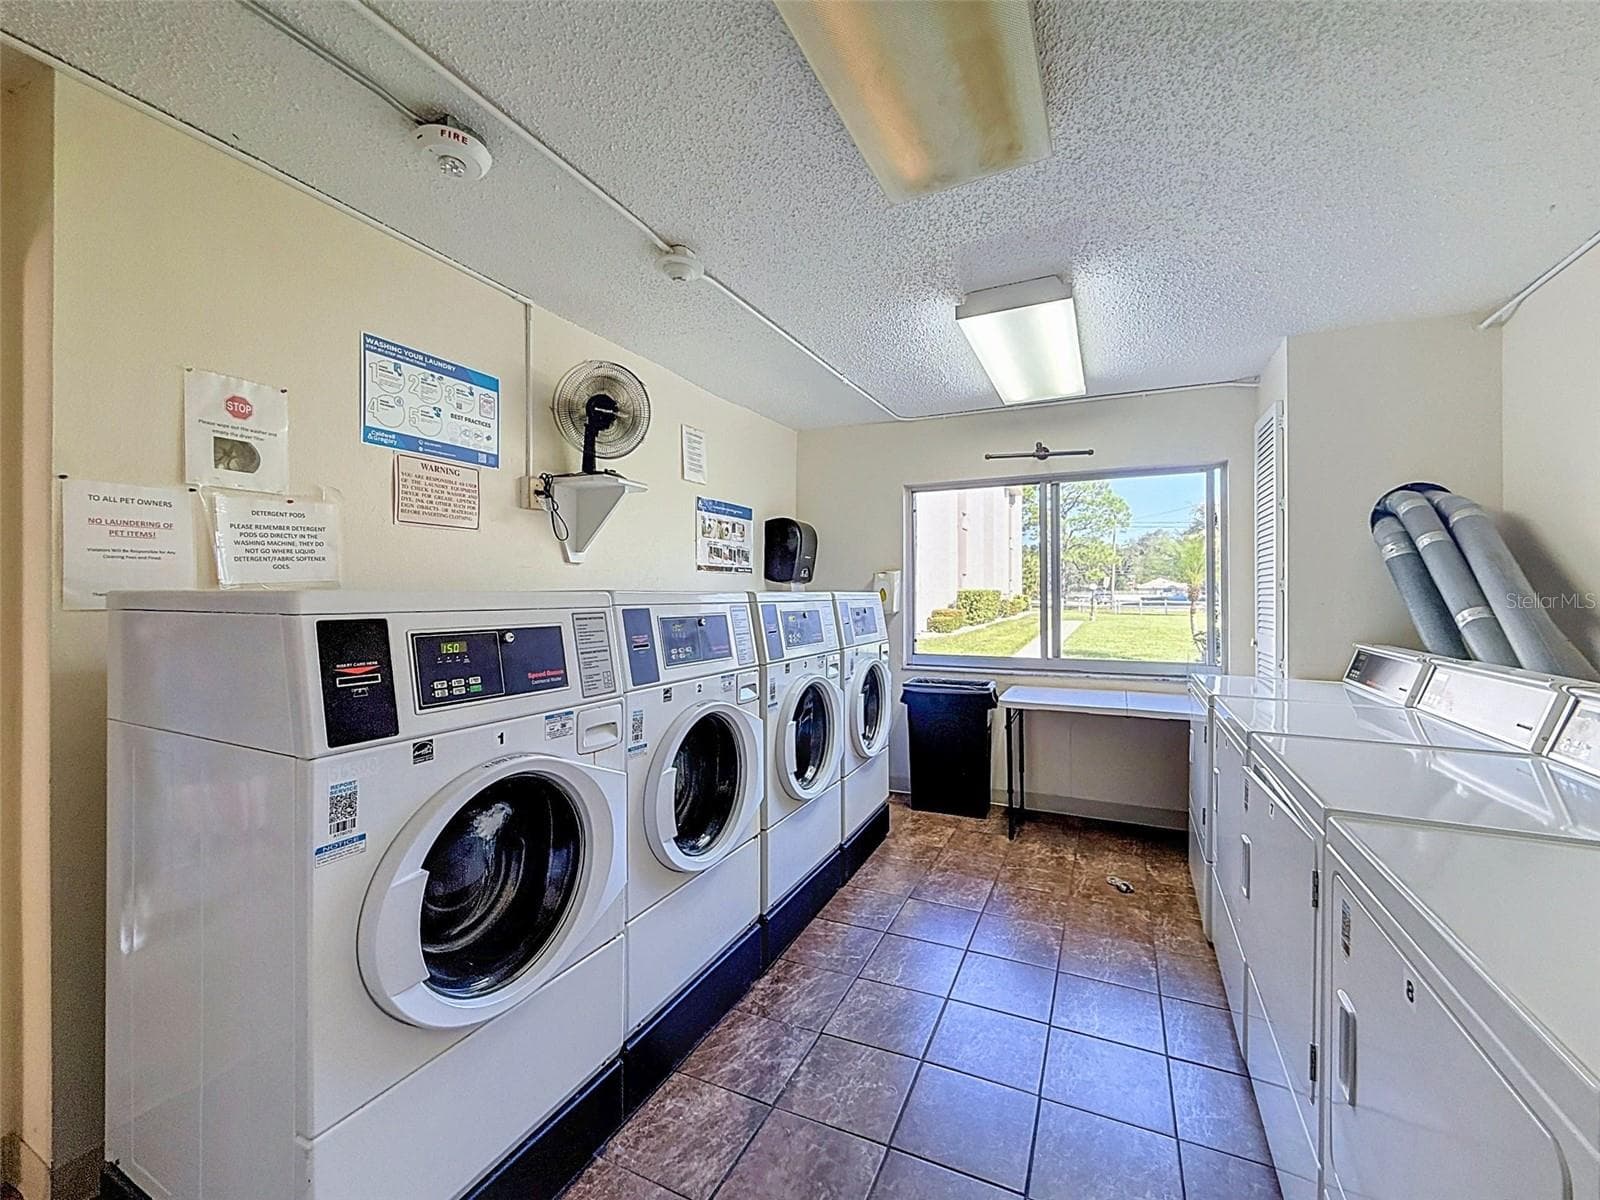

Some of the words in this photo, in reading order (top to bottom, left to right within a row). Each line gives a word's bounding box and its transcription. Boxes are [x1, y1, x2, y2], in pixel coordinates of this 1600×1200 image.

[440, 129, 468, 145] FIRE
[365, 336, 402, 354] WASHING
[404, 350, 424, 362] YOUR
[424, 356, 456, 372] LAUNDRY
[226, 401, 252, 414] STOP
[450, 413, 464, 421] BEST
[464, 416, 492, 428] PRACTICES
[420, 462, 460, 477] WARNING
[88, 494, 100, 502] TO
[102, 495, 118, 503] ALL
[137, 498, 172, 508] OWNERS
[252, 510, 288, 518] DETERGENT
[88, 517, 102, 525] NO
[105, 518, 160, 528] LAUNDERING
[127, 530, 156, 538] ITEMS!
[442, 643, 460, 653] 150
[528, 670, 546, 679] Speed
[697, 684, 702, 693] 2
[497, 732, 504, 744] 1
[330, 780, 356, 790] REPORT
[330, 785, 358, 795] SERVICE
[1270, 803, 1274, 815] 7
[322, 837, 360, 852] NOTICE
[1406, 980, 1414, 1003] 8
